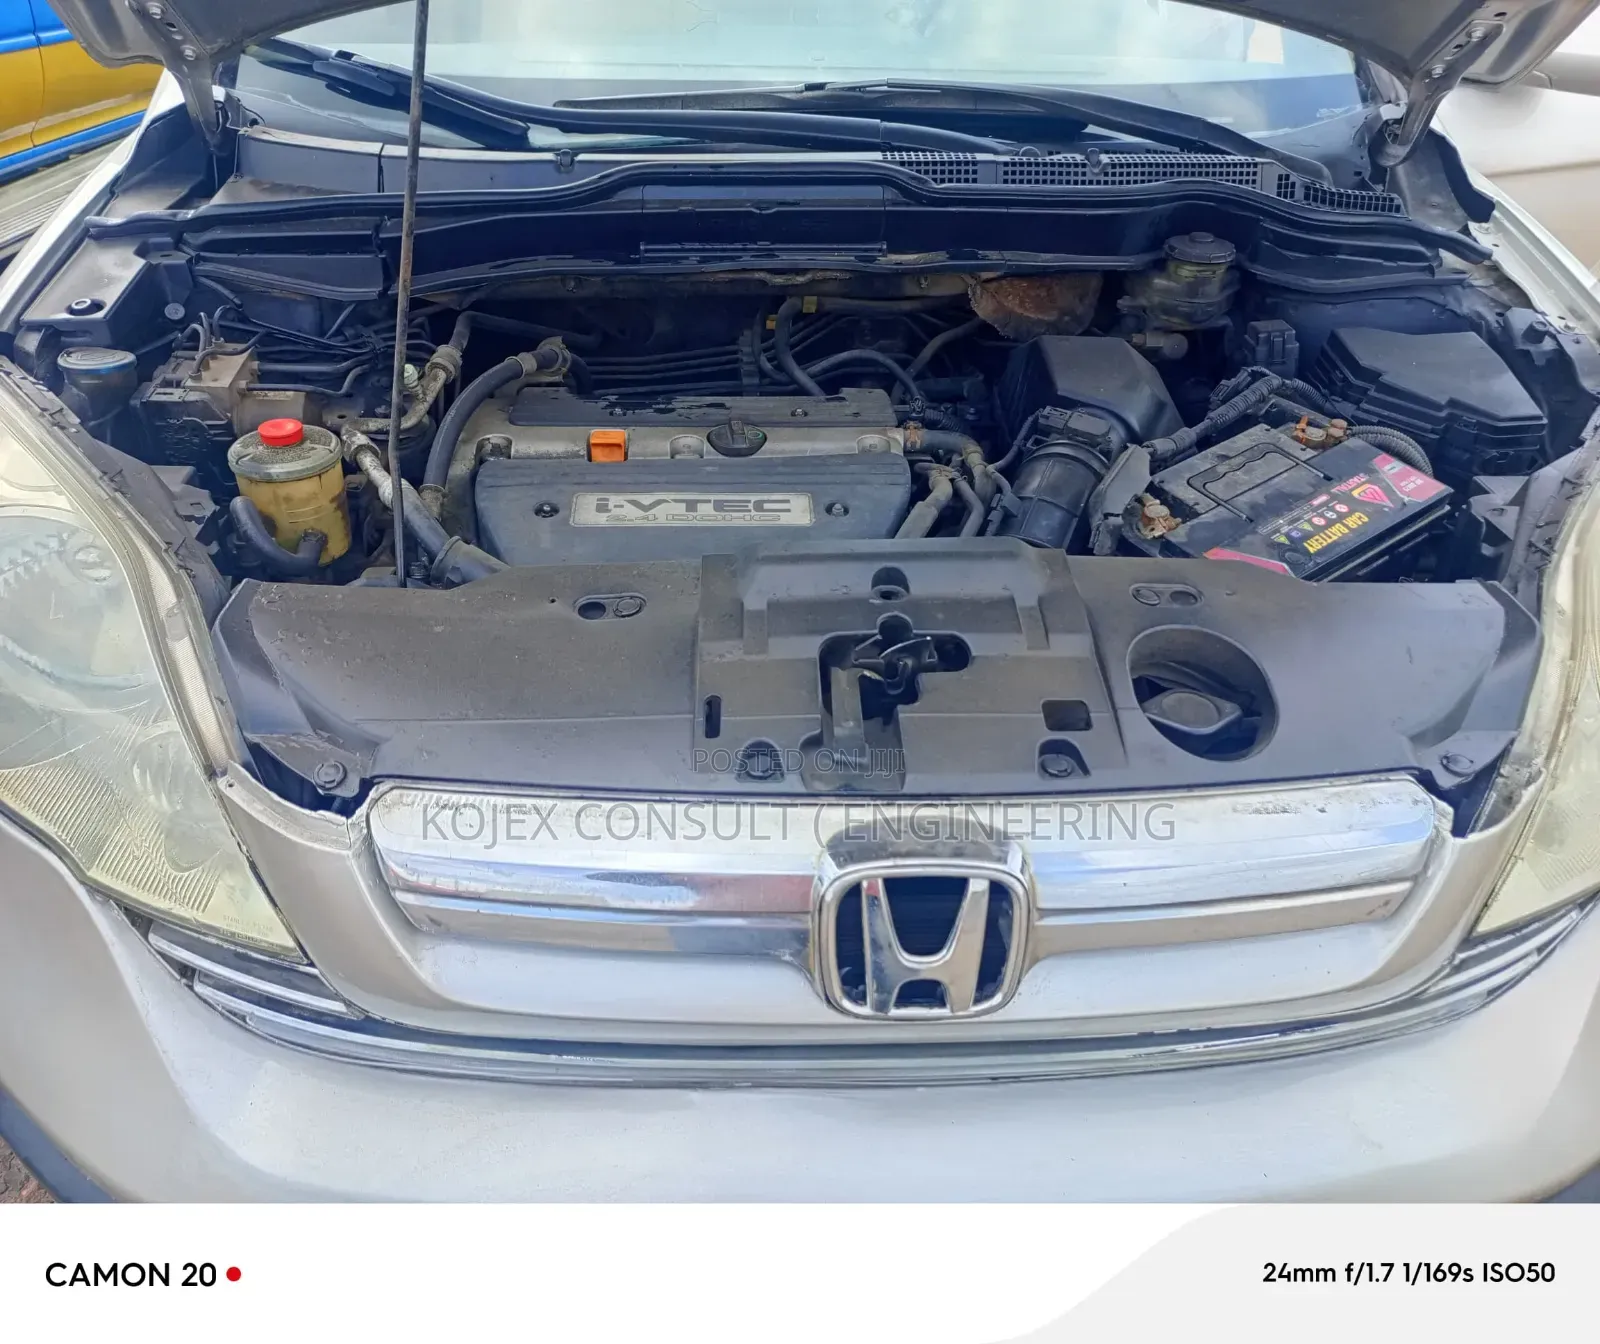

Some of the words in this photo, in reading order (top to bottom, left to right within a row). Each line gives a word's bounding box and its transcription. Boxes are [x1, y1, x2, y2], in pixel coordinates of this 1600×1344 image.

[596, 497, 792, 514] i-VTEC
[606, 513, 659, 522] 2.4
[665, 513, 781, 522] DOHC
[1342, 511, 1370, 529] CAR
[1303, 523, 1350, 554] BATTERY
